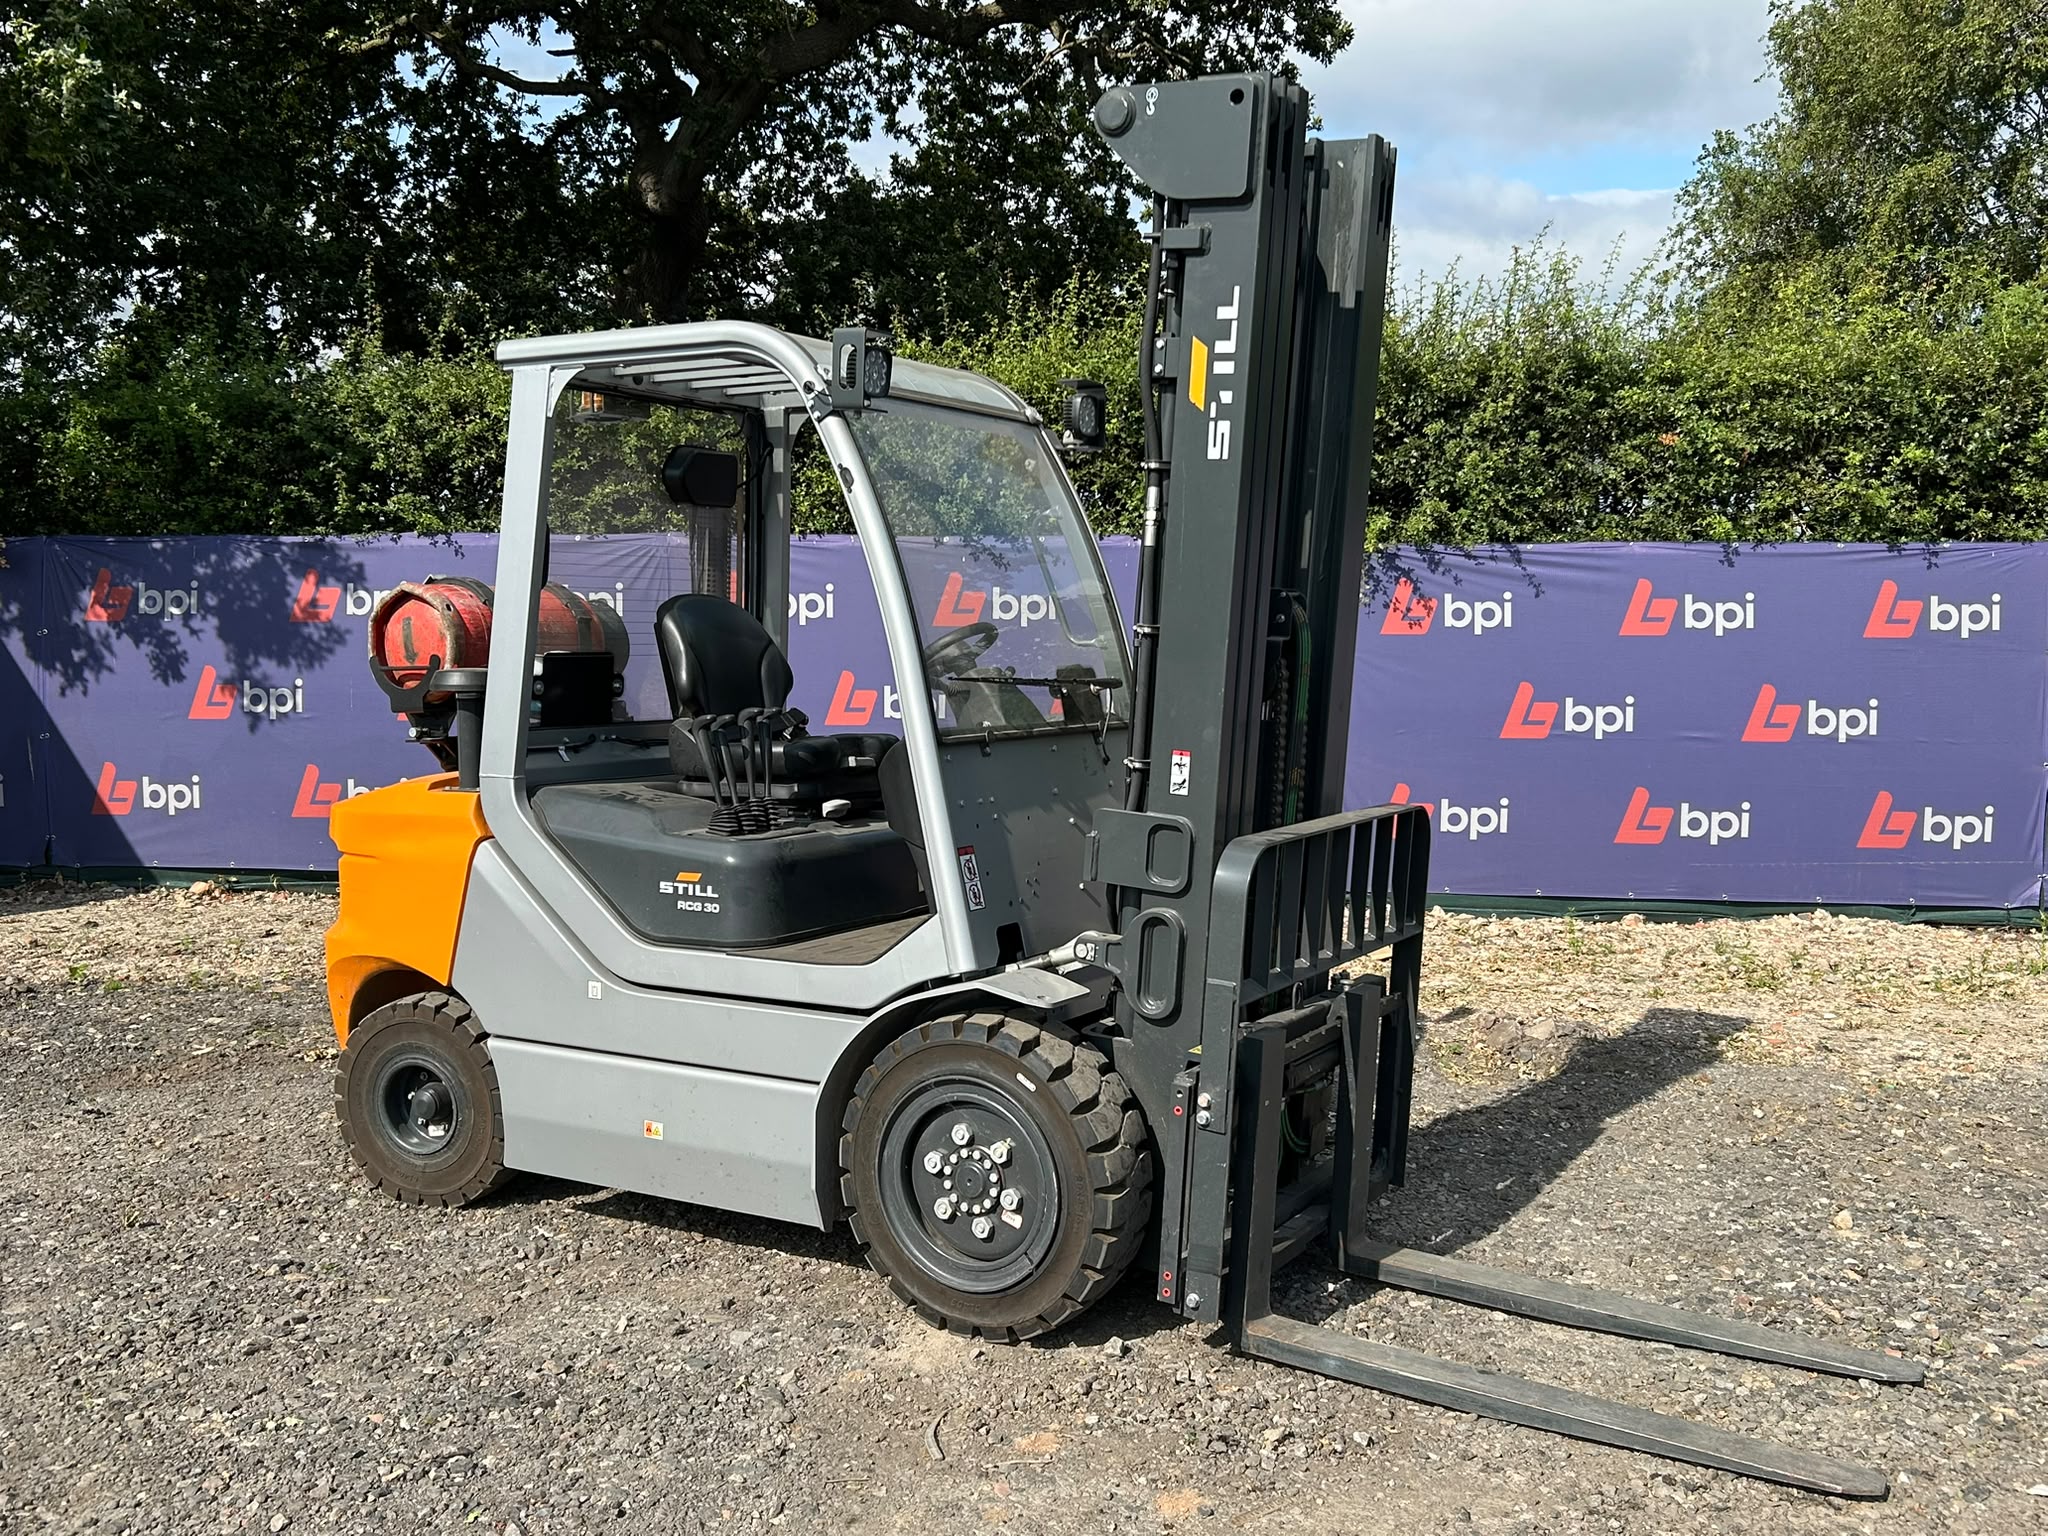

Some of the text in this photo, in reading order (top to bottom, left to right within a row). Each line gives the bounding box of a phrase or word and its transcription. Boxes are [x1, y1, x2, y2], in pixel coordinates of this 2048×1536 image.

[138, 580, 198, 622] bpi
[1444, 591, 1513, 635] bpi
[1684, 592, 1755, 637] bpi
[1930, 593, 2001, 639] bpi
[242, 677, 304, 720] bpi
[1564, 694, 1635, 740] bpi
[1807, 698, 1879, 743] bpi
[141, 774, 200, 816] bpi
[1440, 797, 1509, 841] bpi
[1679, 801, 1751, 845] bpi
[1922, 805, 1995, 850] bpi
[659, 881, 719, 898] STILL
[677, 900, 720, 914] RCG 30
